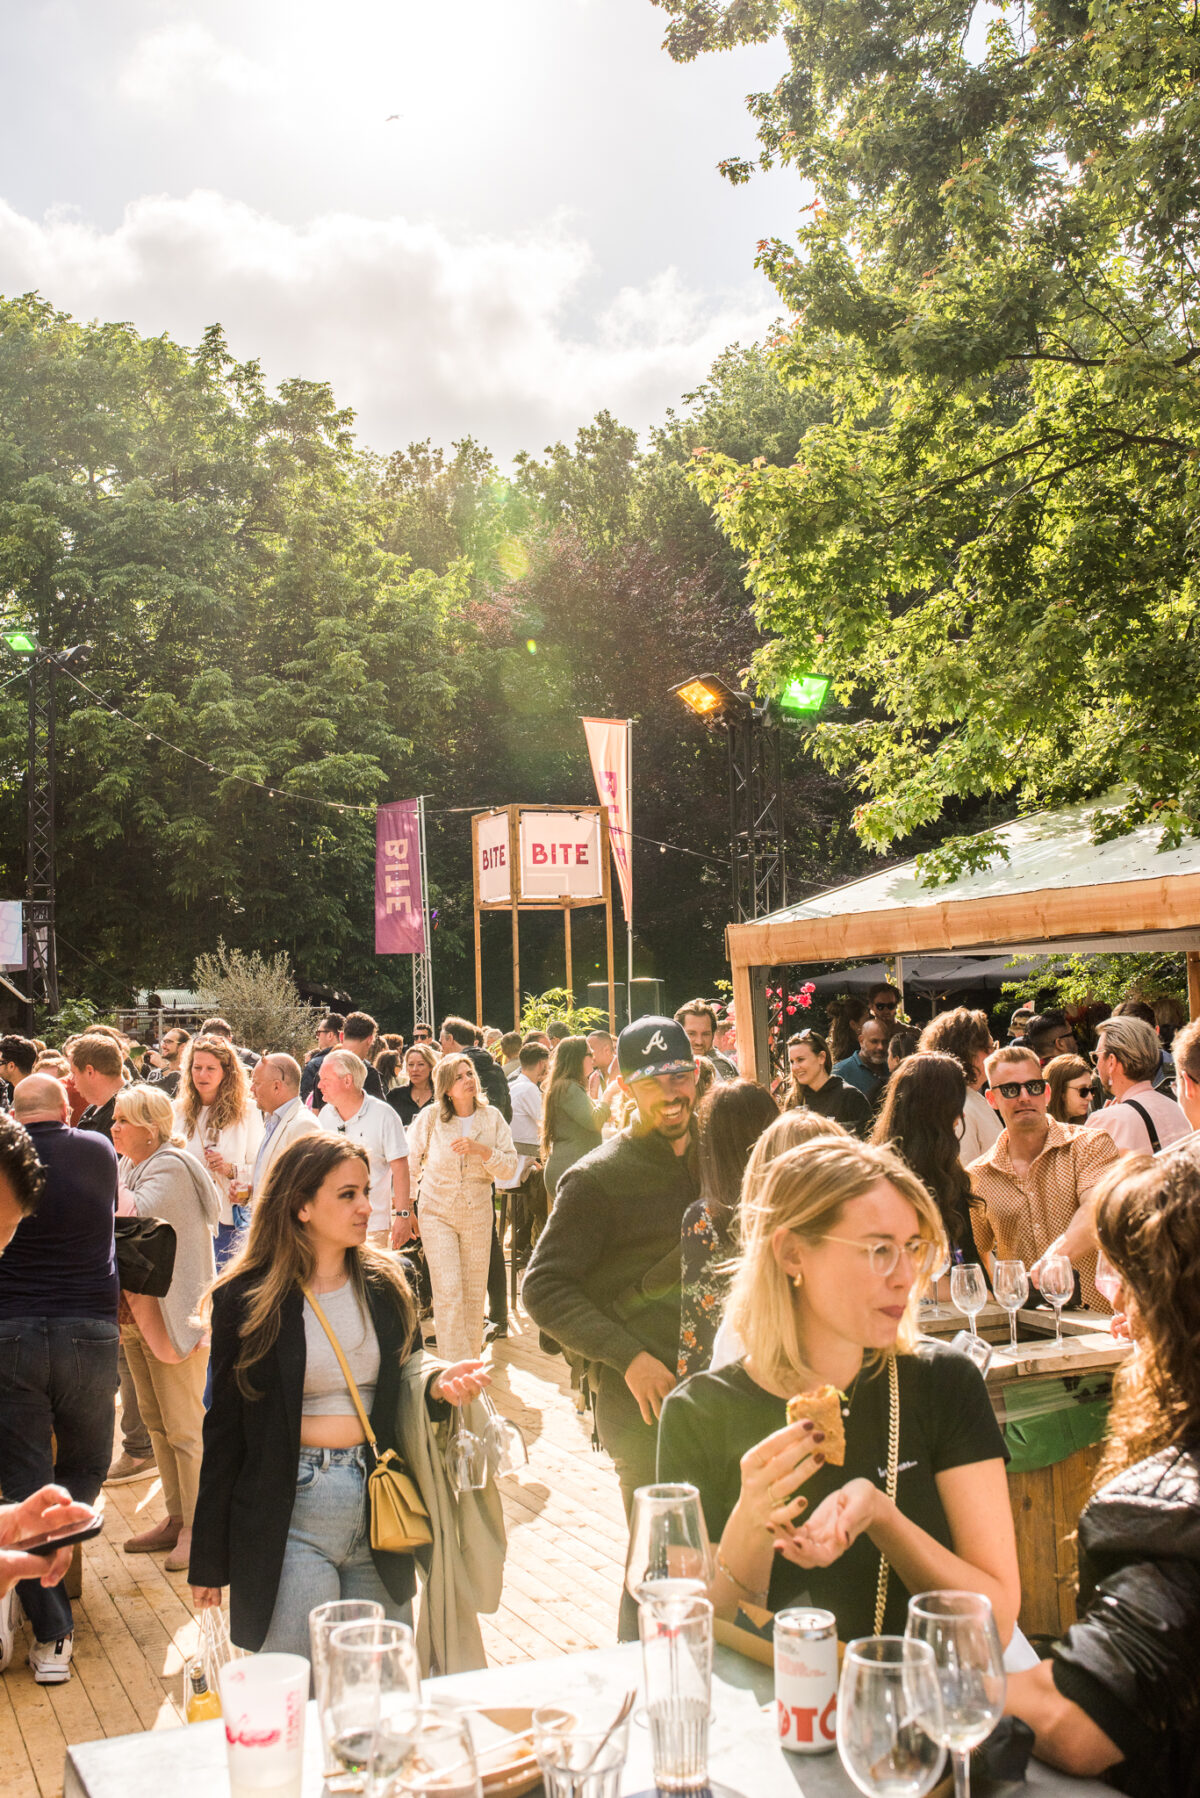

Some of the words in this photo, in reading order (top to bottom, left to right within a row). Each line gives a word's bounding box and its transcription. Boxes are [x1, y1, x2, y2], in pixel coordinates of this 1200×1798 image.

[482, 844, 506, 870] BITE
[531, 843, 589, 865] BITE
[384, 838, 412, 914] BITE
[641, 1030, 668, 1055] A
